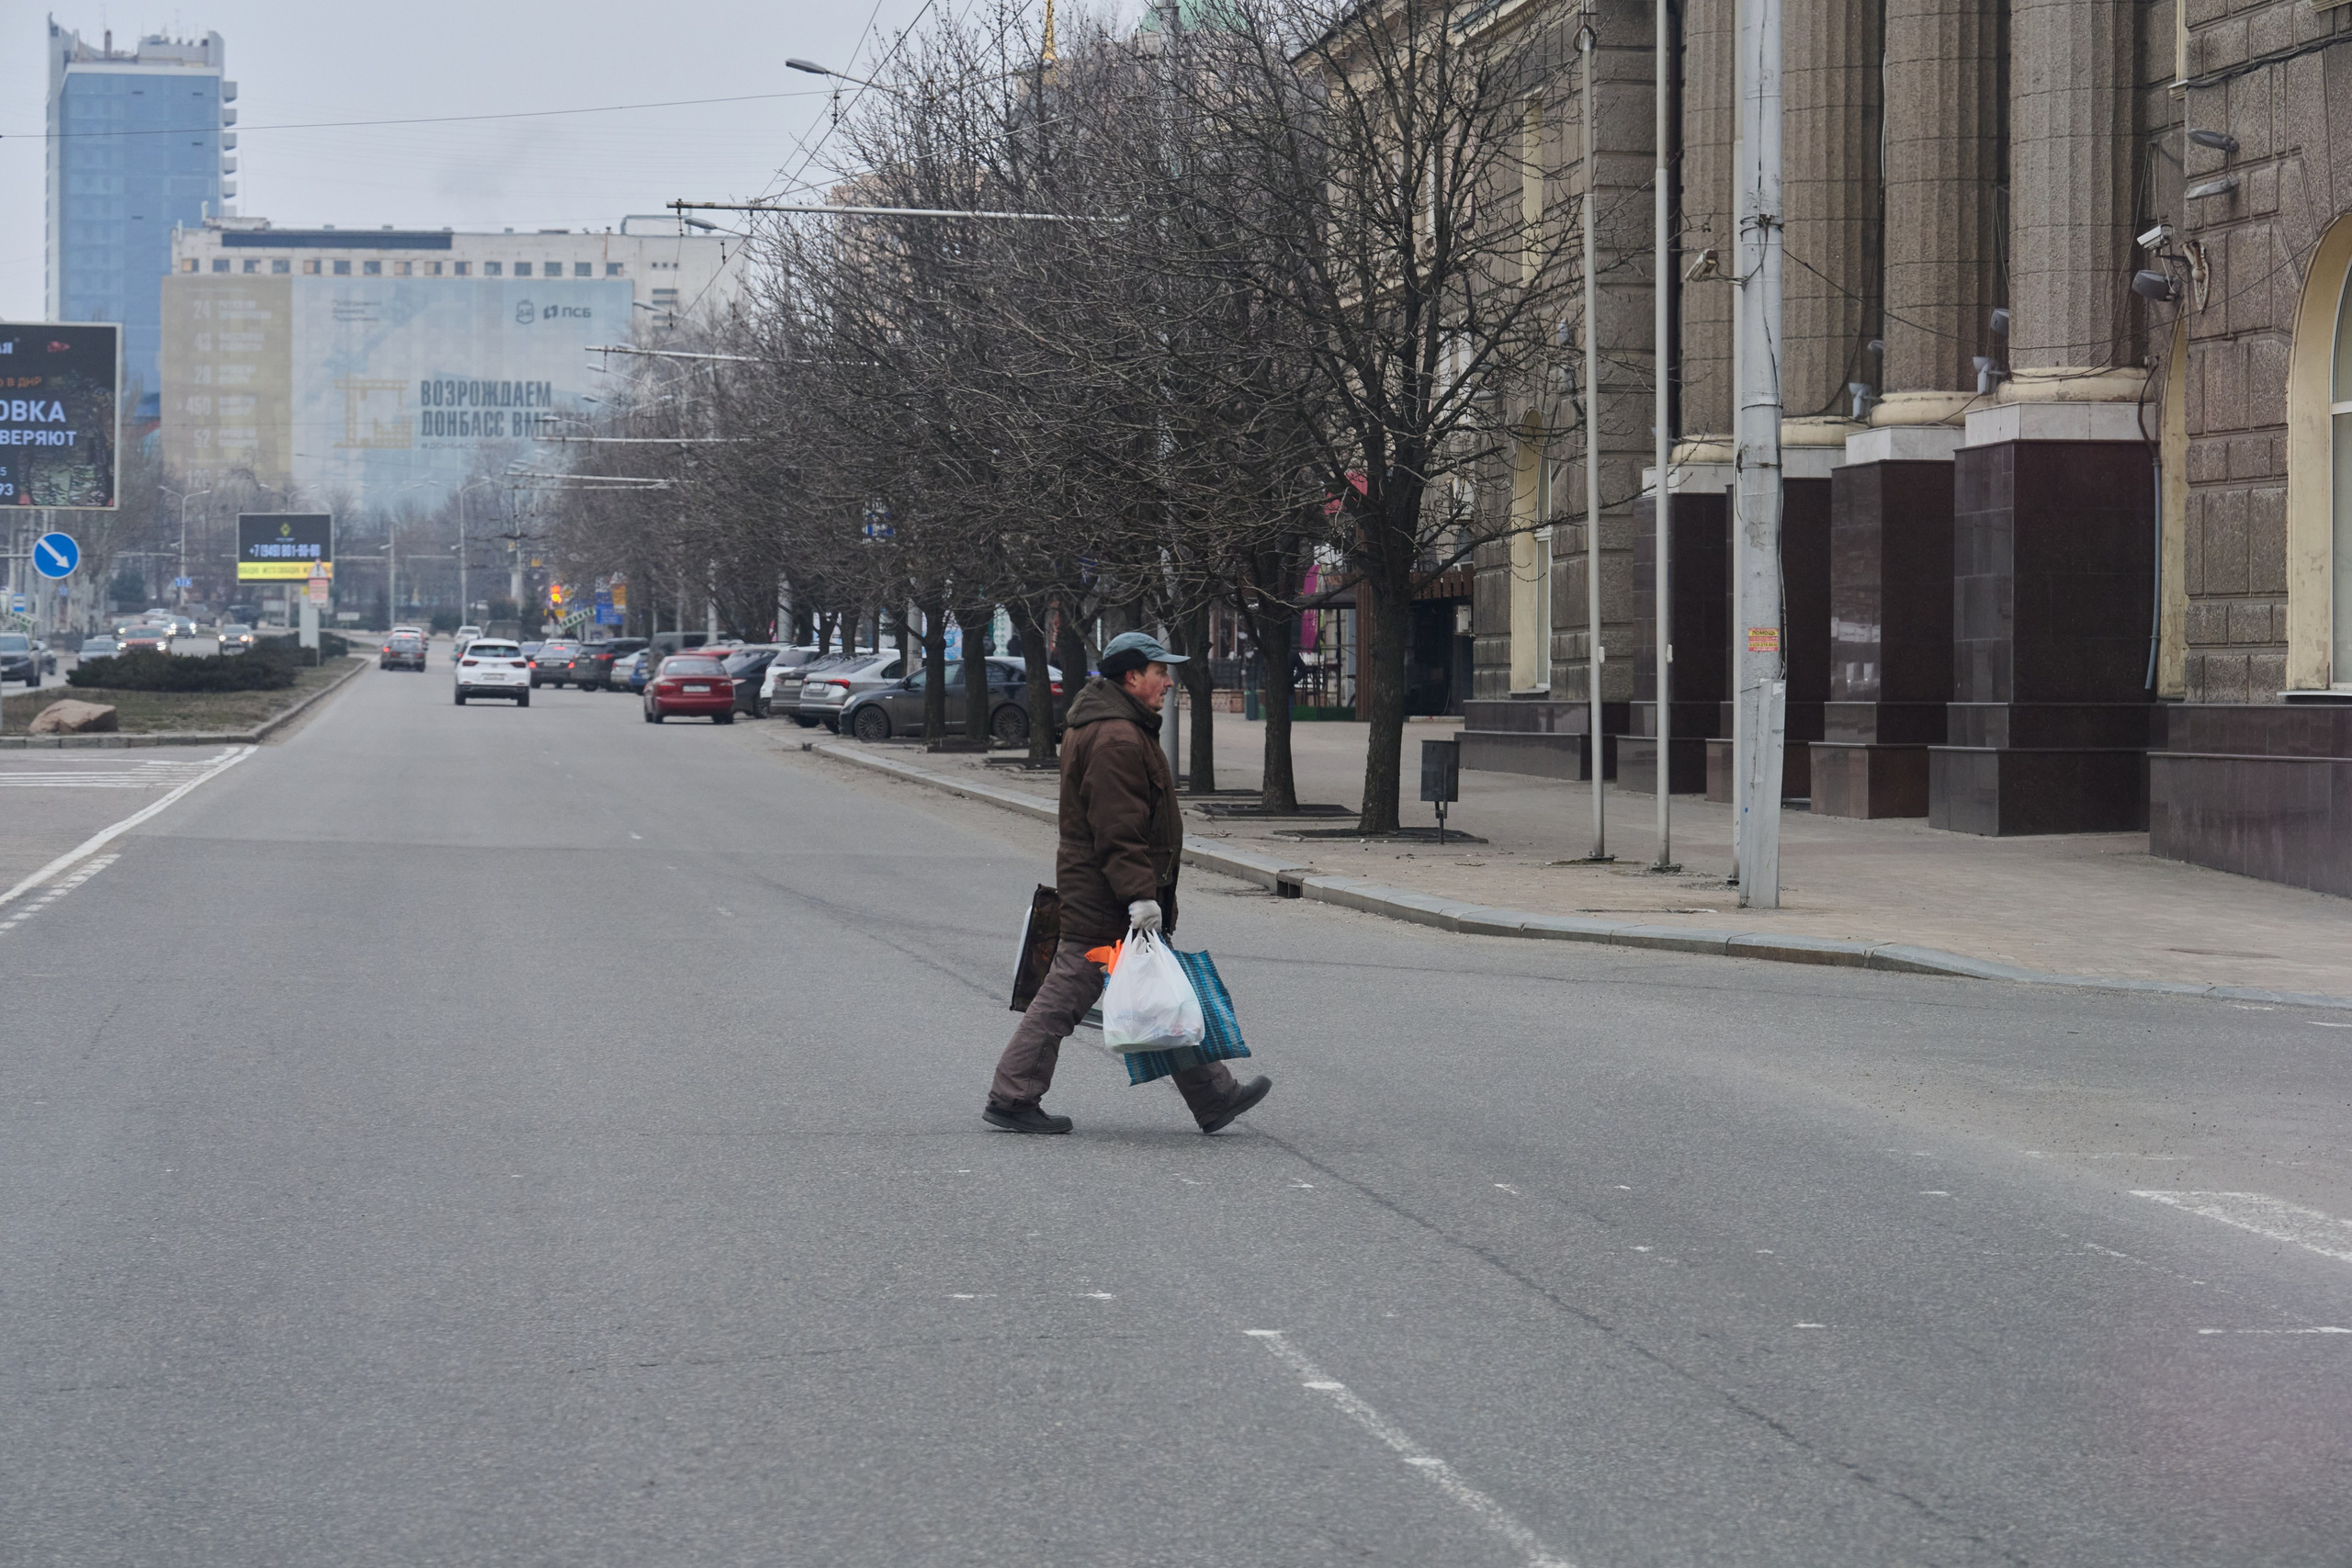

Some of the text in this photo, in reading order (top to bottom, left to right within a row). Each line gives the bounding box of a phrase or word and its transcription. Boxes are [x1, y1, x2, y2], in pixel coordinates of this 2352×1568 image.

[561, 306, 592, 318] ПСБ
[420, 379, 552, 407] ВОЗРОЖДАЕМ
[420, 411, 504, 437] ДОНБАСС
